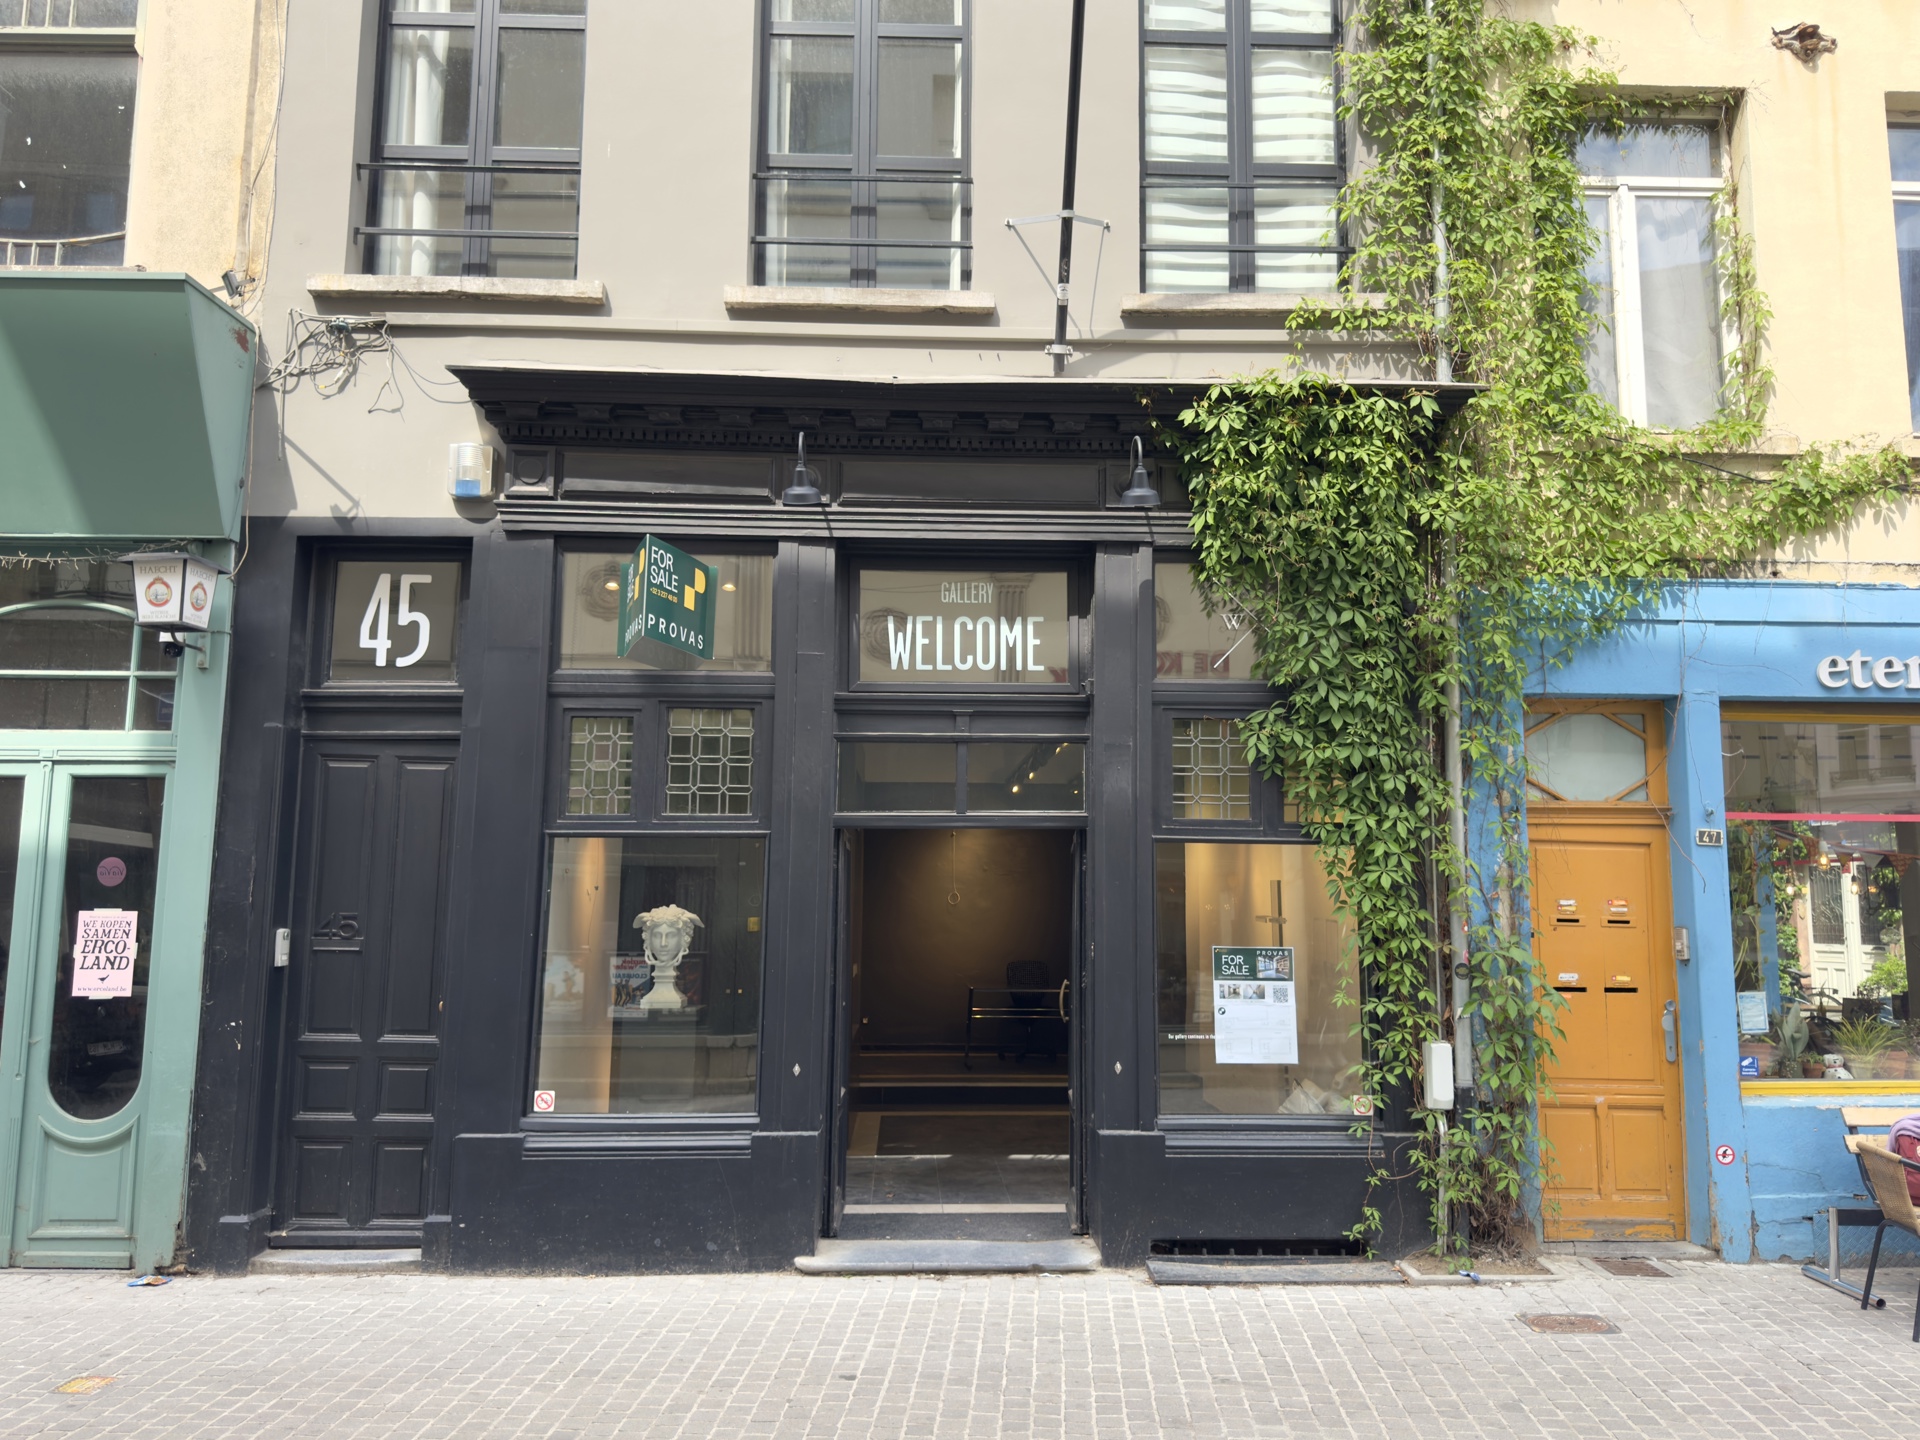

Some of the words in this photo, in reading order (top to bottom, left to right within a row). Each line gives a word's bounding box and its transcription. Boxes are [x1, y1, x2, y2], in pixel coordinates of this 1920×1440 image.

[651, 545, 673, 572] FOR
[139, 565, 178, 574] HAECHT
[650, 565, 679, 593] SALE
[941, 582, 994, 604] GALLERY
[359, 573, 432, 667] 45
[624, 614, 643, 646] PROVAS
[648, 613, 704, 649] PROVAS
[887, 615, 1045, 671] WELCOME
[1703, 831, 1717, 844] 47
[82, 928, 132, 939] SAMEN
[83, 920, 98, 928] WE
[100, 920, 132, 928] KOPEN
[313, 912, 359, 940] 45
[81, 939, 131, 955] ERCO-
[79, 955, 130, 970] LAND
[1222, 955, 1244, 965] FOR
[1222, 965, 1250, 975] SALE
